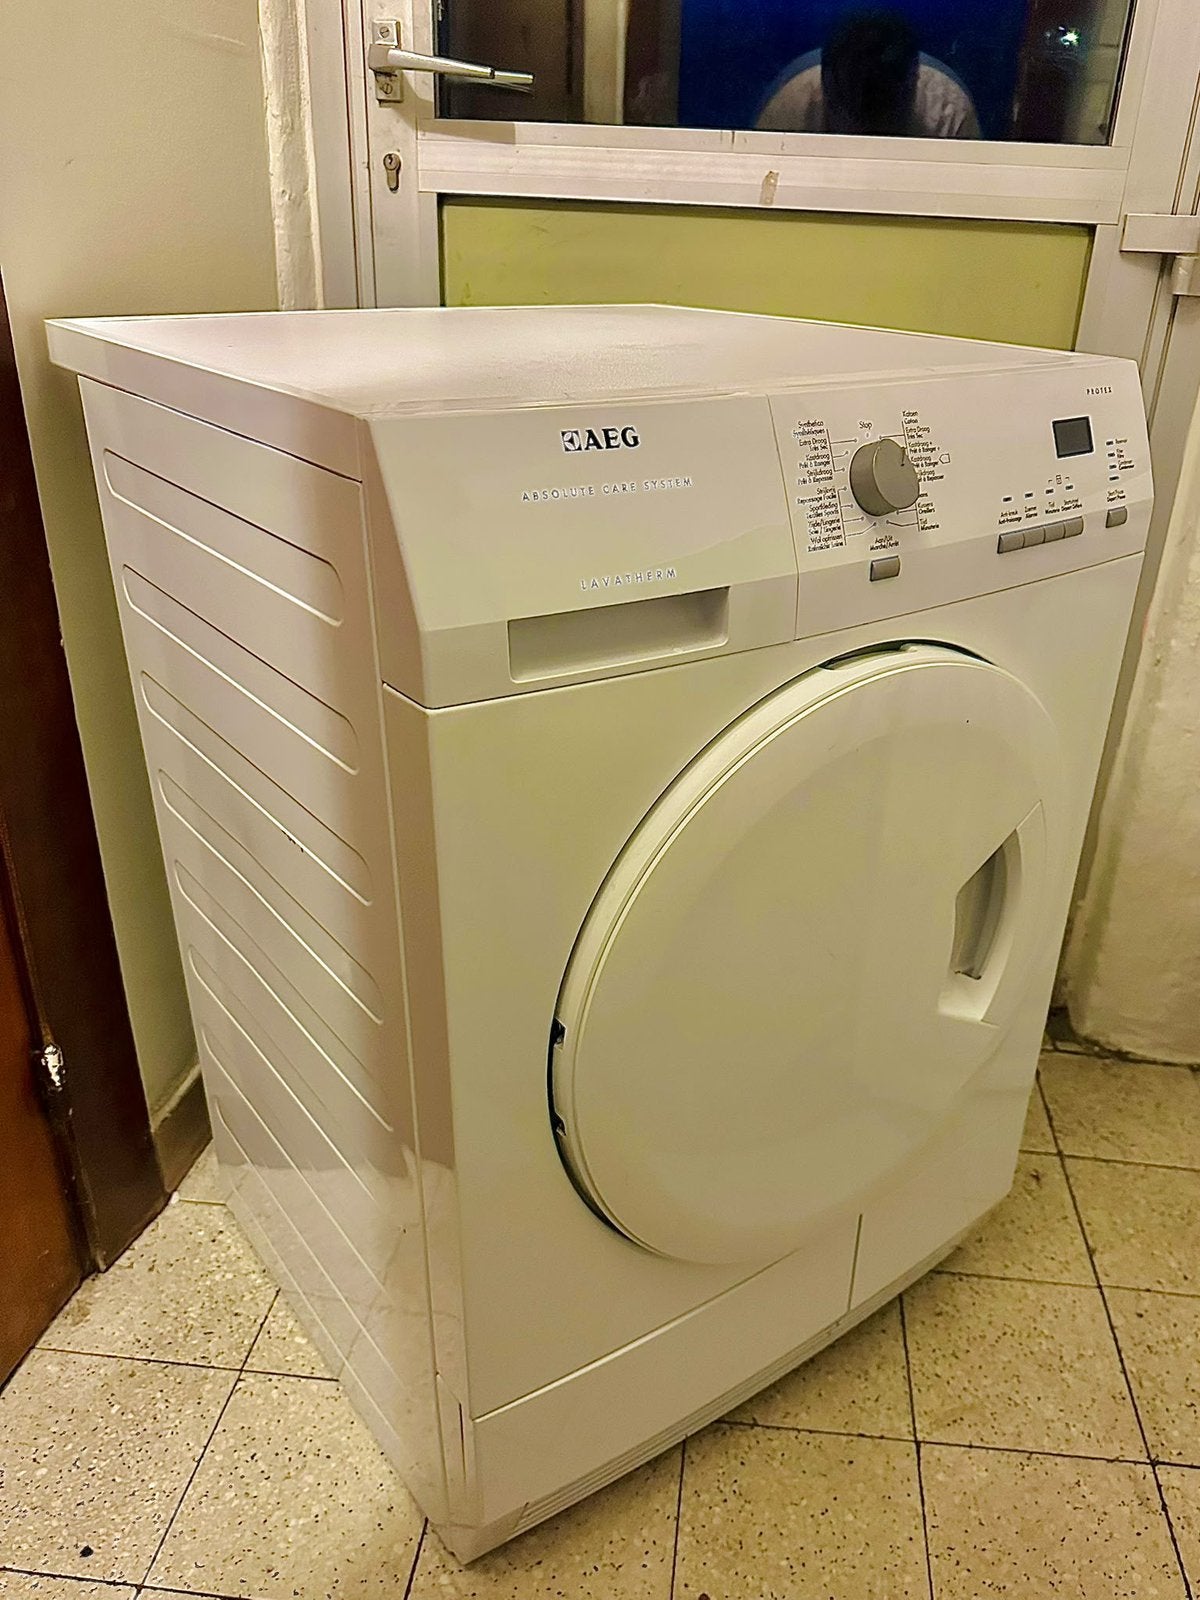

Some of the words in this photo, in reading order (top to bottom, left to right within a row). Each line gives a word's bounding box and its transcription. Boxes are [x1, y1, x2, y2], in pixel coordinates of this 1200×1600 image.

[1087, 386, 1112, 395] PROTEX
[859, 420, 872, 430] Stop
[584, 426, 640, 450] AEG
[522, 486, 595, 501] ABSOLUTE
[602, 482, 636, 494] CARE
[644, 477, 692, 490] SYSTEM
[580, 568, 676, 590] LAVATHERM
